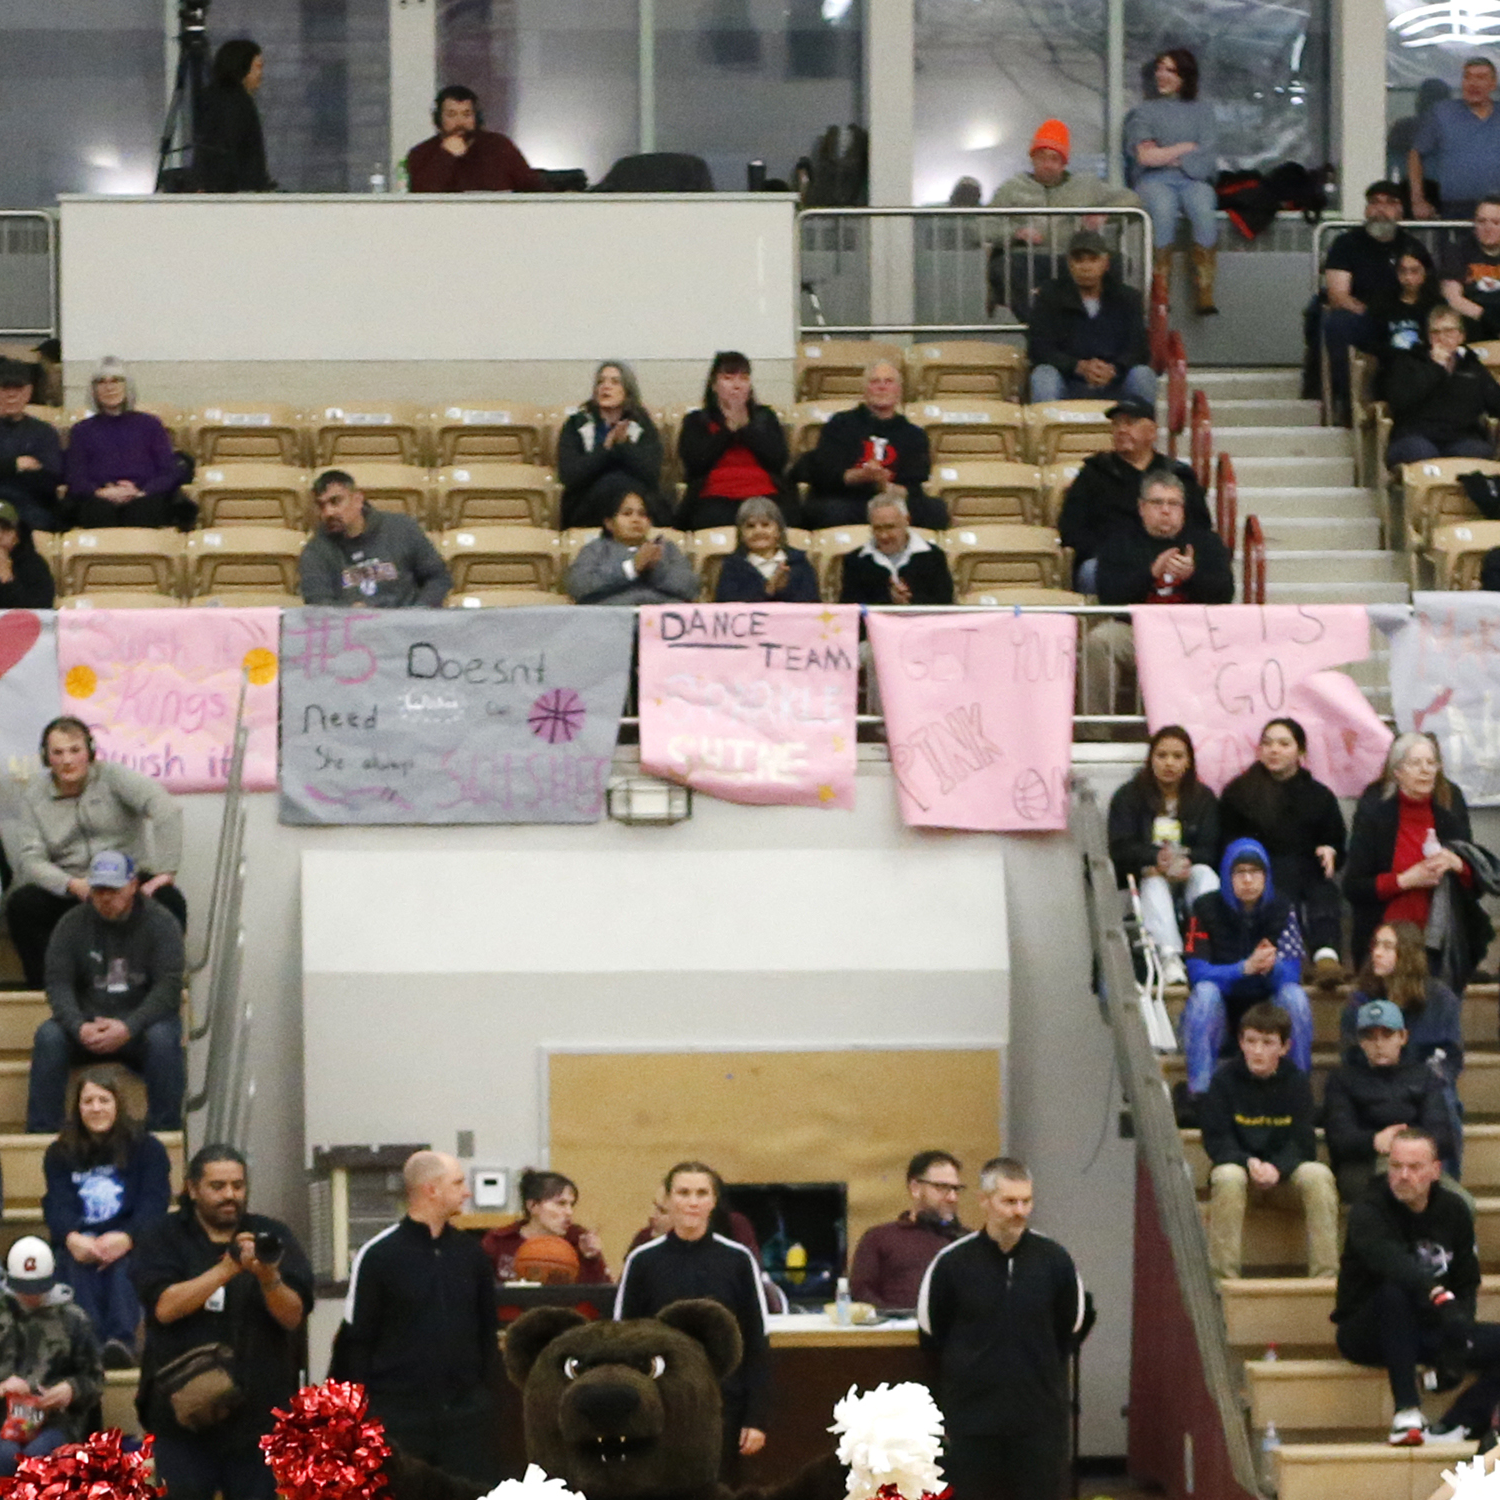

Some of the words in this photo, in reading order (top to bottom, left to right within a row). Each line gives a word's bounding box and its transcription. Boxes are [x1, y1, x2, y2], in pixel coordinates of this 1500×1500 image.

[288, 613, 381, 686] #5
[661, 609, 770, 642] DANCE
[757, 642, 854, 672] TEAM
[112, 663, 227, 733] Kings
[1214, 657, 1286, 714] GO
[896, 702, 1004, 812] PINK
